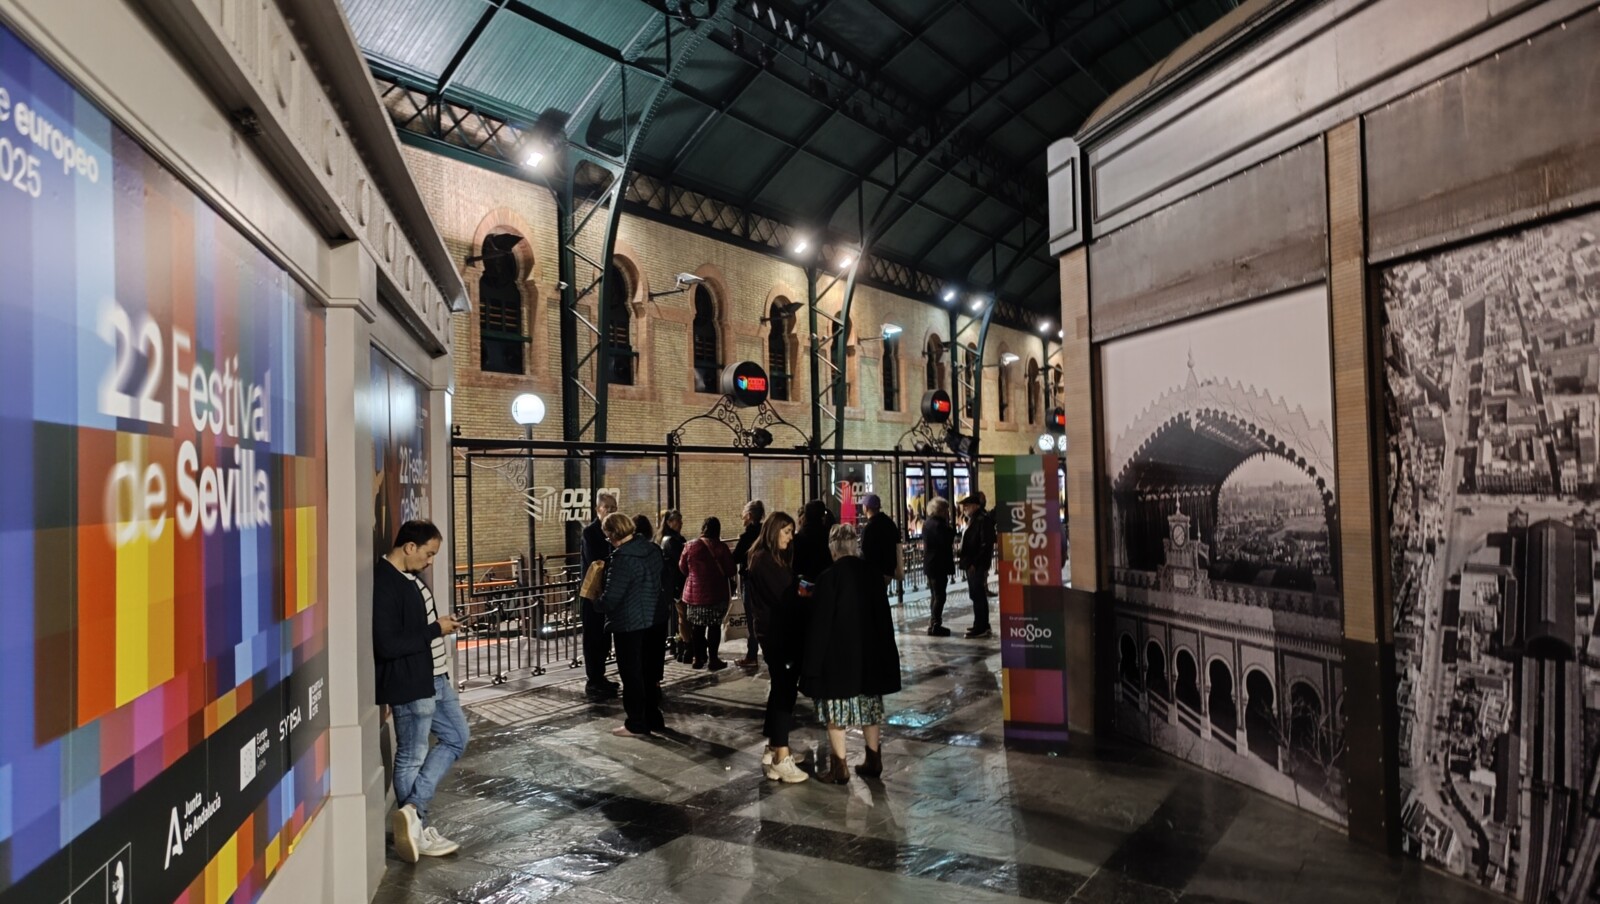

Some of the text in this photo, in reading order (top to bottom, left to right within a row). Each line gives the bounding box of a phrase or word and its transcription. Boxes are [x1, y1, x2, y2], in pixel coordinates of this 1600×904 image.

[0, 137, 41, 198] 025
[14, 102, 98, 184] europeo
[98, 300, 271, 442] 22 Festival
[104, 432, 270, 546] de Sevilla
[400, 446, 408, 484] 22
[1004, 501, 1028, 584] Festival
[1026, 470, 1050, 585] de Sevilla
[184, 792, 202, 819] Junta
[184, 791, 222, 842] de Andalucía
